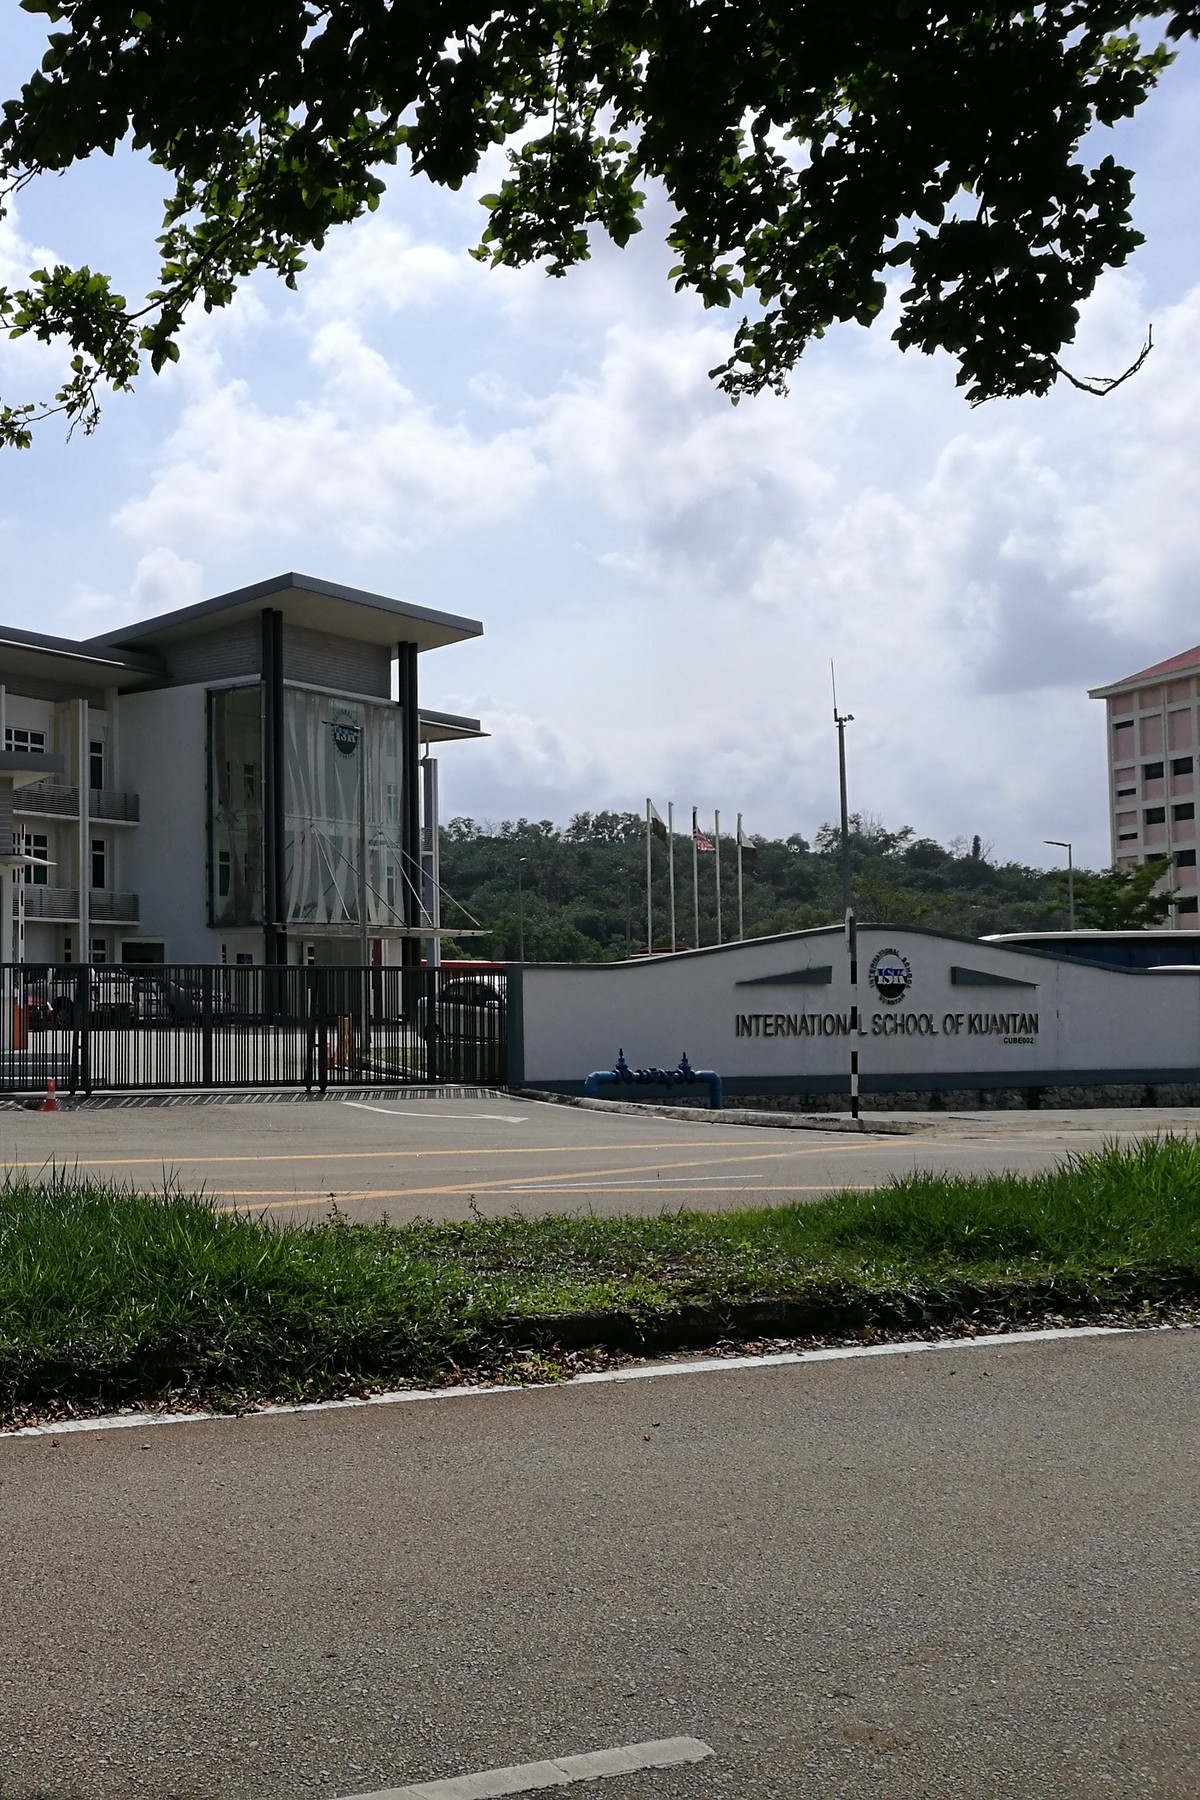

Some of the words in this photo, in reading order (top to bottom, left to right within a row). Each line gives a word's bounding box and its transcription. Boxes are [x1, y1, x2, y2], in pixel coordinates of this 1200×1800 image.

[877, 967, 906, 985] ISK
[735, 1013, 868, 1037] INTERNATIONL
[871, 1013, 938, 1035] SCHOOL
[942, 1013, 965, 1035] OF
[967, 1012, 1039, 1035] KUANTAN
[1003, 1036, 1034, 1044] CUBE002
